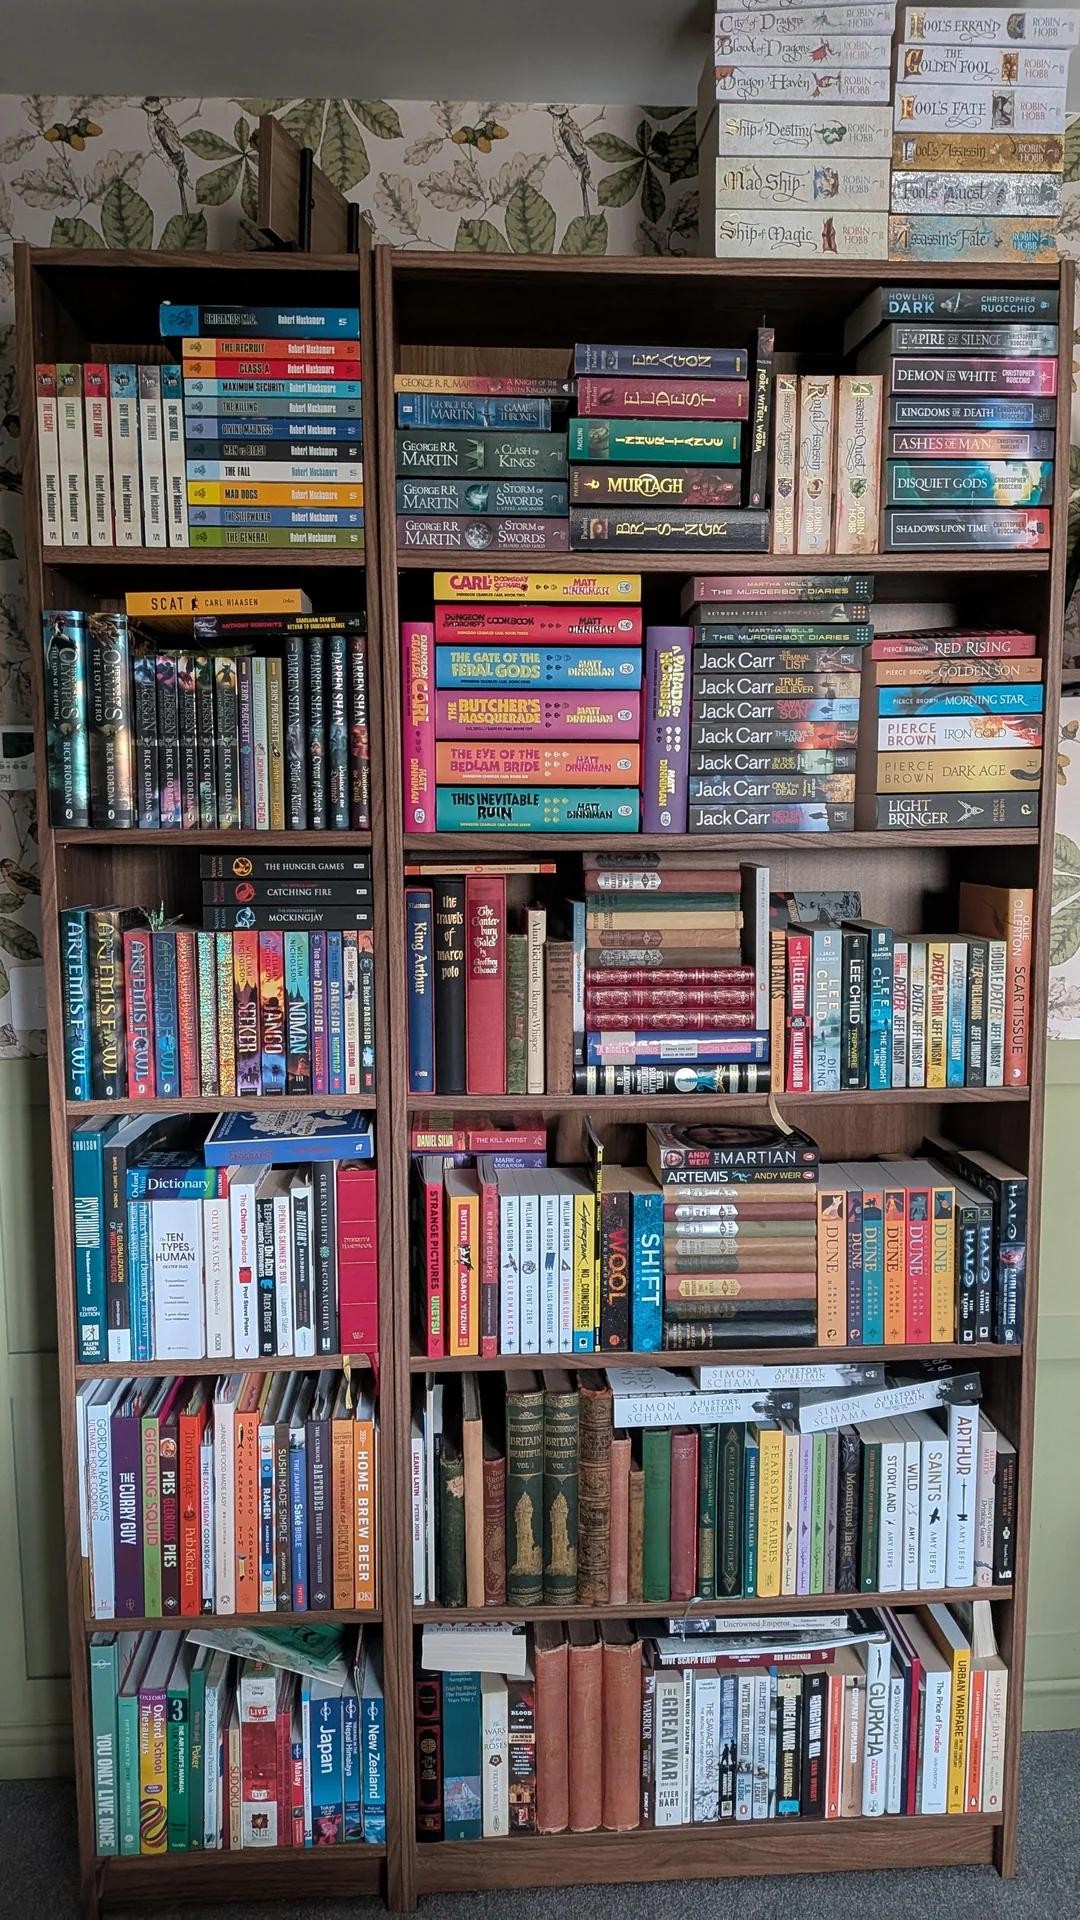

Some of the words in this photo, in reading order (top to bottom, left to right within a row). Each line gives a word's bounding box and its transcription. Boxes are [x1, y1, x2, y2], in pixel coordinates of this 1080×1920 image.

[910, 12, 951, 38] FOOL'S
[954, 21, 1000, 32] ERRAND
[1032, 17, 1060, 26] ROBIN
[1034, 27, 1057, 37] HOBB
[945, 49, 962, 59] THE
[905, 49, 954, 79] GOLDEN
[958, 60, 993, 74] FOOL
[901, 96, 948, 119] FOOL'S
[952, 101, 986, 116] FATE
[720, 221, 758, 247] Ship
[889, 293, 934, 301] HOWLING
[981, 295, 1035, 303] CHRISTOPHER
[889, 302, 935, 314] DARK
[981, 304, 1035, 314] RUOCCHIO
[632, 354, 711, 368] ERAGON
[239, 363, 261, 374] CLASS
[264, 363, 270, 373] A
[897, 370, 943, 382] DEMON
[947, 371, 956, 380] IN
[958, 370, 997, 382] WHITE
[222, 383, 253, 392] MAXIMUM
[255, 383, 285, 392] SECURITY
[624, 392, 716, 406] ELDEST
[901, 408, 950, 417] KINGDOMS
[402, 441, 436, 452] GEORGE
[615, 436, 723, 447] INHERITANCE
[501, 445, 529, 455] CLASH
[402, 452, 458, 466] MARTIN
[499, 456, 535, 468] KINGS
[225, 467, 237, 476] THE
[238, 467, 251, 476] FALL
[291, 468, 309, 477] Robert
[310, 468, 338, 477] Muchamore
[608, 474, 684, 496] MURTAGH
[898, 478, 950, 491] DISQUIET
[953, 478, 988, 489] GODS
[225, 489, 238, 499] MAD
[240, 489, 258, 499] DOGS
[616, 522, 727, 536] BRISINGR
[896, 524, 940, 533] SHADOWS
[941, 524, 964, 532] UPON
[967, 524, 987, 532] TIME
[226, 532, 239, 542] THE
[242, 532, 269, 542] GENERAL
[450, 576, 494, 590] CARL'S
[573, 578, 597, 587] MATT
[562, 586, 609, 595] DINNIMAN
[151, 598, 183, 610] SCAT
[205, 599, 224, 607] CARL
[226, 598, 258, 607] HIAASEN
[934, 642, 962, 654] RED
[966, 641, 1011, 653] RISING
[451, 653, 469, 662] THE
[473, 653, 499, 663] GATE
[503, 654, 516, 663] OF
[519, 653, 540, 663] THE
[700, 653, 735, 669] Jack
[738, 653, 775, 668] Carr
[331, 652, 344, 692] DARREN
[452, 664, 493, 677] FERAL
[495, 664, 540, 678] GODS
[775, 685, 814, 693] BELIEVER
[779, 678, 803, 687] TRUE
[332, 697, 344, 725] SHAN
[459, 699, 540, 713] BUTCHER'S
[459, 713, 541, 723] MASQUERADE
[888, 723, 936, 734] PIERCE
[888, 734, 936, 746] BROWN
[63, 742, 72, 764] RICK
[63, 767, 72, 805] RIORDAN
[452, 793, 474, 805] THIS
[477, 793, 539, 805] INEVITABLE
[478, 807, 512, 819] RUIN
[889, 801, 931, 812] LIGHT
[889, 812, 948, 825] BRINGER
[267, 888, 308, 896] CATCHING
[311, 888, 332, 896] FIRE
[443, 896, 456, 908] the
[268, 914, 324, 922] MOCKINGJAY
[437, 911, 463, 925] travels
[1012, 900, 1023, 956] OLLERTON
[412, 922, 427, 950] King
[444, 928, 456, 944] of
[437, 950, 463, 961] marco
[414, 954, 427, 994] Arthur
[442, 965, 459, 979] polo
[1013, 965, 1026, 1002] SCAR
[816, 970, 827, 1021] CHILD
[828, 979, 838, 1009] LEE
[314, 981, 324, 1033] DARKSIDE
[238, 1001, 257, 1053] SEEKER
[289, 1002, 307, 1054] NOMAN
[1011, 1006, 1025, 1054] TISSUE
[817, 1048, 826, 1086] TRYING
[828, 1058, 836, 1075] DIE
[721, 1151, 796, 1164] MARTIAN
[667, 1169, 729, 1183] ARTEMIS
[754, 1171, 778, 1180] ANDY
[779, 1171, 801, 1179] WEIR
[148, 1177, 210, 1191] Dictionary
[430, 1190, 438, 1240] STRANGE
[75, 1197, 100, 1249] PSYCHOLOGY
[166, 1233, 184, 1242] TEN
[160, 1243, 190, 1251] TYPES
[825, 1226, 839, 1274] DUNE
[155, 1252, 195, 1261] HUMAN
[431, 1243, 439, 1289] PICTURES
[641, 1233, 660, 1306] SHIFT
[431, 1296, 440, 1335] UKETSU
[633, 1403, 676, 1412] SIMON
[627, 1412, 682, 1423] SCHAMA
[510, 1437, 542, 1446] BRITAIN
[956, 1416, 972, 1475] ARTHUR
[119, 1472, 134, 1482] THE
[357, 1450, 369, 1492] HOME
[907, 1463, 918, 1491] WILD
[927, 1452, 942, 1501] SAINTS
[887, 1455, 897, 1513] STORYLAND
[119, 1482, 136, 1522] CURRY
[357, 1498, 369, 1539] BREW
[120, 1524, 137, 1545] GUY
[357, 1544, 369, 1582] BEER
[957, 1660, 967, 1693] URBAN
[664, 1688, 677, 1696] THE
[662, 1698, 678, 1742] GREAT
[866, 1683, 885, 1757] GURKHA
[954, 1694, 965, 1738] WARFARE
[368, 1724, 379, 1750] New
[316, 1725, 336, 1774] Japan
[662, 1746, 678, 1780] WAR
[368, 1752, 380, 1799] Zealand
[230, 1766, 240, 1808] SUDOKU
[659, 1799, 678, 1807] HART
